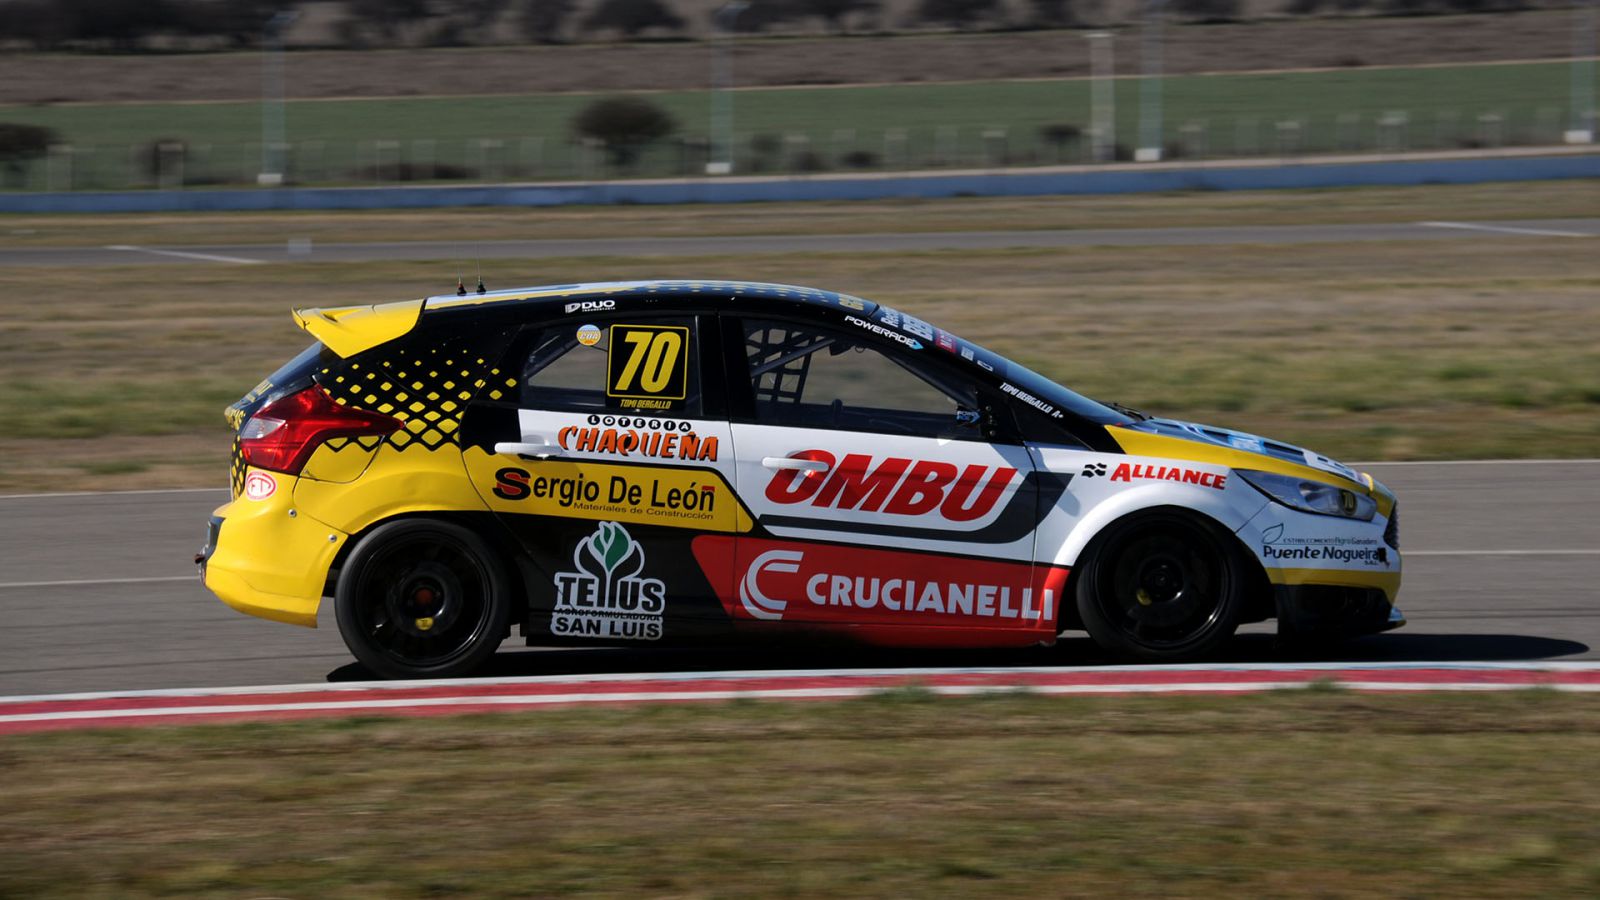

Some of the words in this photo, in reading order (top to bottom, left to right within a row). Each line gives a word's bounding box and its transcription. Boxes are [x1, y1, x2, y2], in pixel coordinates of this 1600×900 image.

[582, 300, 615, 308] DUO
[844, 315, 914, 346] POWERADE
[615, 331, 681, 393] 70
[620, 399, 637, 409] TOMI
[637, 400, 672, 409] BERGALLO
[1000, 382, 1020, 396] TOMI
[1016, 391, 1053, 413] BERGALLO
[587, 414, 691, 432] LOTERIA
[558, 425, 718, 462] CHAQUEÑA
[492, 467, 599, 508] Sergio
[608, 475, 642, 505] De
[651, 479, 716, 512] León
[765, 449, 1018, 521] OMBU
[1110, 463, 1227, 490] ALLIANCE
[573, 502, 627, 514] Materiales
[646, 508, 714, 520] Construcción
[1263, 545, 1320, 560] Puente
[1322, 546, 1379, 563] Nogueira
[806, 573, 1054, 621] CRUCIANELLI
[555, 617, 600, 635] SAN
[609, 620, 660, 638] LUIS
